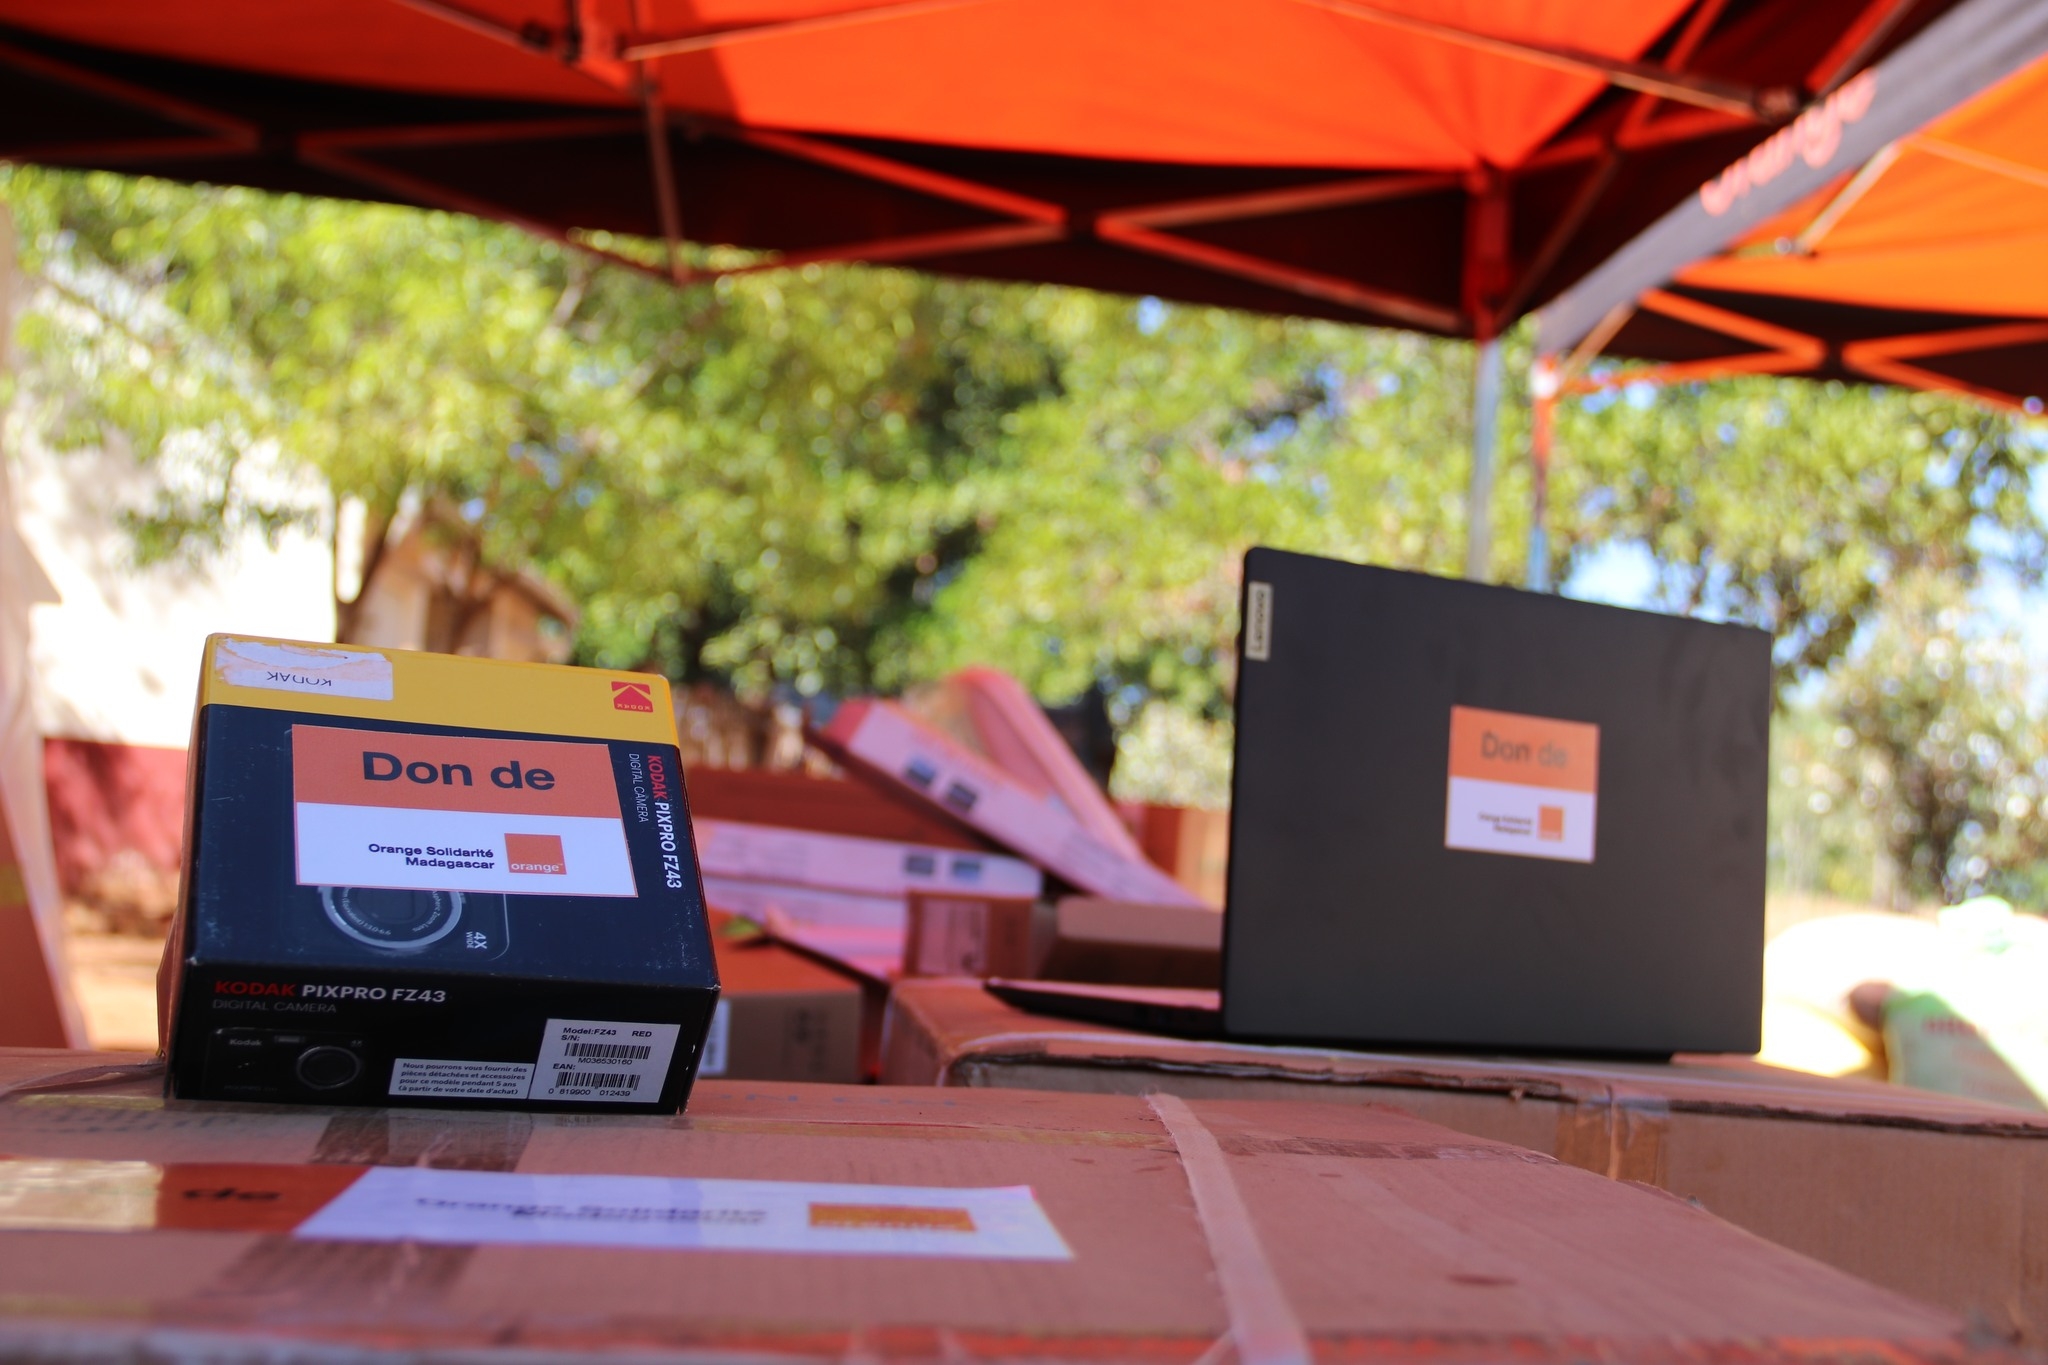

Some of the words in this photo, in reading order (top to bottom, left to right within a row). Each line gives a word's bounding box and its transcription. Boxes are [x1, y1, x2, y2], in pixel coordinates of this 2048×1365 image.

[1480, 731, 1531, 763] Don
[1537, 744, 1567, 767] de
[362, 751, 473, 786] Don
[490, 760, 555, 790] de
[628, 753, 643, 784] DIGITAL
[647, 755, 668, 799] KODAK
[633, 786, 649, 823] CAMERA
[655, 801, 676, 852] PIXPRO
[368, 843, 422, 856] Orange
[426, 845, 494, 859] Solidarité
[405, 857, 495, 870] Madagascar
[662, 854, 682, 889] FZ43
[465, 931, 475, 949] WIDE
[473, 931, 487, 949] 4X
[215, 981, 297, 997] KODAK
[302, 984, 387, 1000] PIXPRO
[391, 989, 447, 1003] FZ43
[212, 999, 269, 1011] DIGITAL
[273, 1001, 337, 1013] CAMERA
[560, 1034, 581, 1042] S/N:
[562, 1027, 617, 1036] Model:FZ43
[229, 1038, 262, 1046] Kodak
[559, 1088, 592, 1096] 819900
